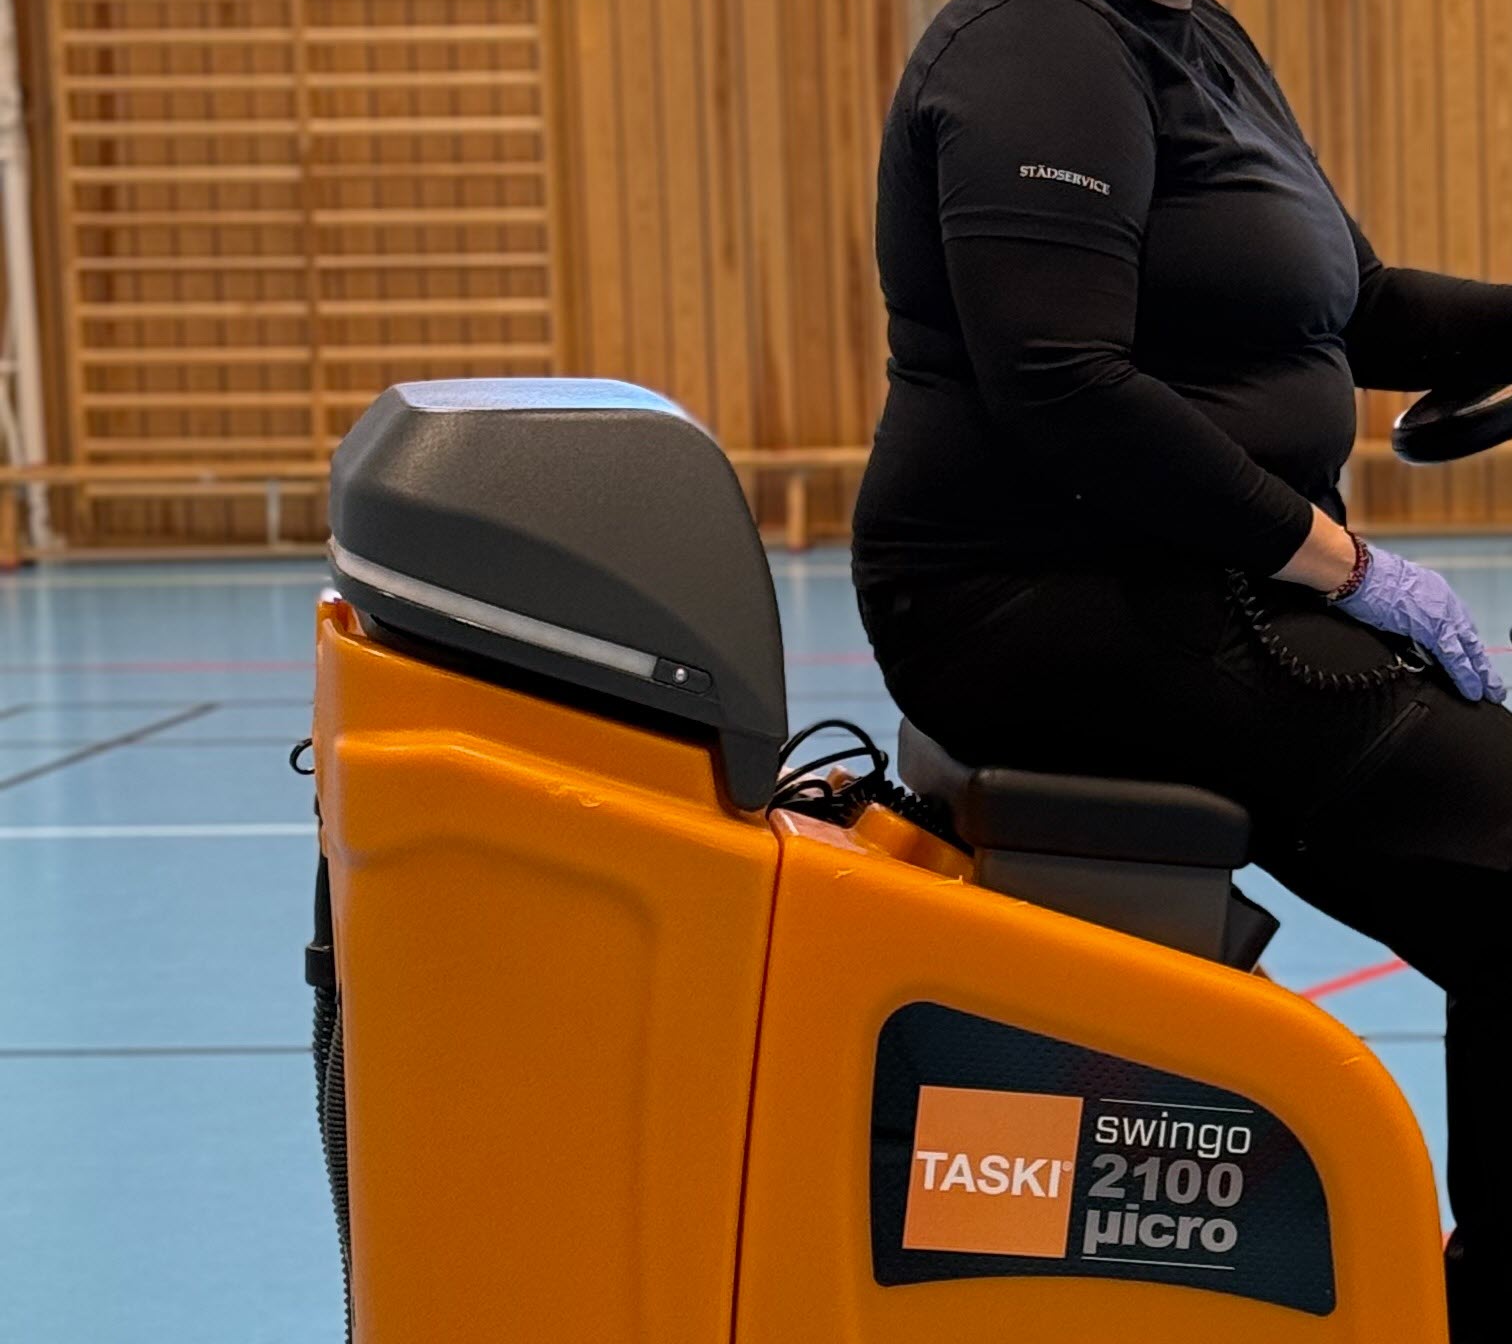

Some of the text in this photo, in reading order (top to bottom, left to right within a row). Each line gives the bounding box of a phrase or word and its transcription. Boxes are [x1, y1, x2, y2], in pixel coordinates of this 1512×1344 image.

[1019, 164, 1111, 195] STÄDSERVICE
[1095, 1111, 1251, 1158] swingo
[1087, 1155, 1244, 1208] 2100
